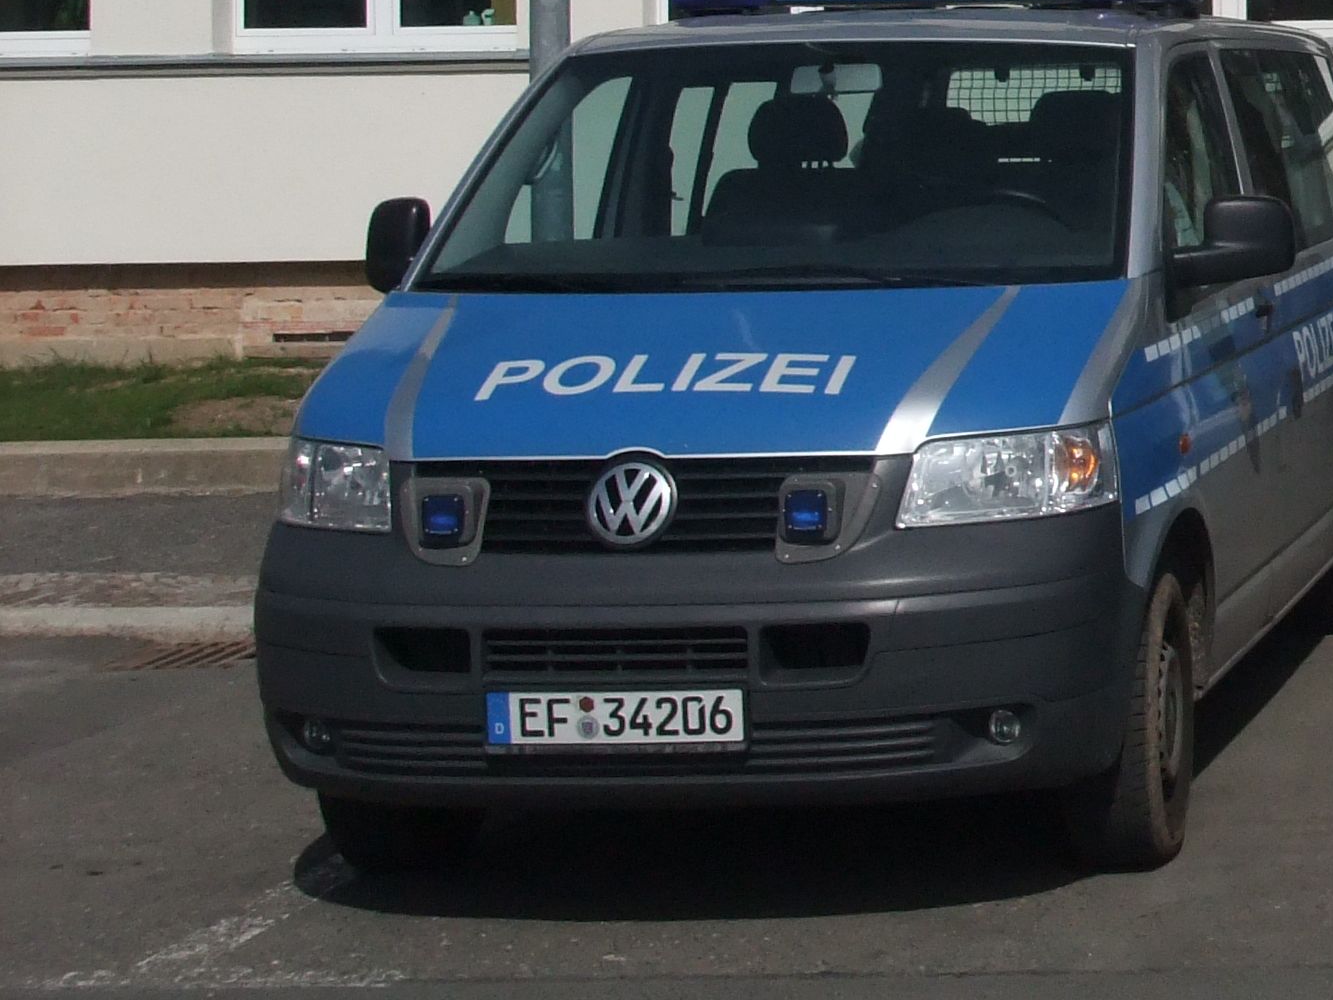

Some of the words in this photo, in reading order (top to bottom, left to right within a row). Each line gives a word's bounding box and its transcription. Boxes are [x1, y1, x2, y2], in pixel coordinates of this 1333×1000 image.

[474, 352, 857, 401] POLIZEI
[519, 698, 571, 737] EF
[602, 696, 733, 737] 34206
